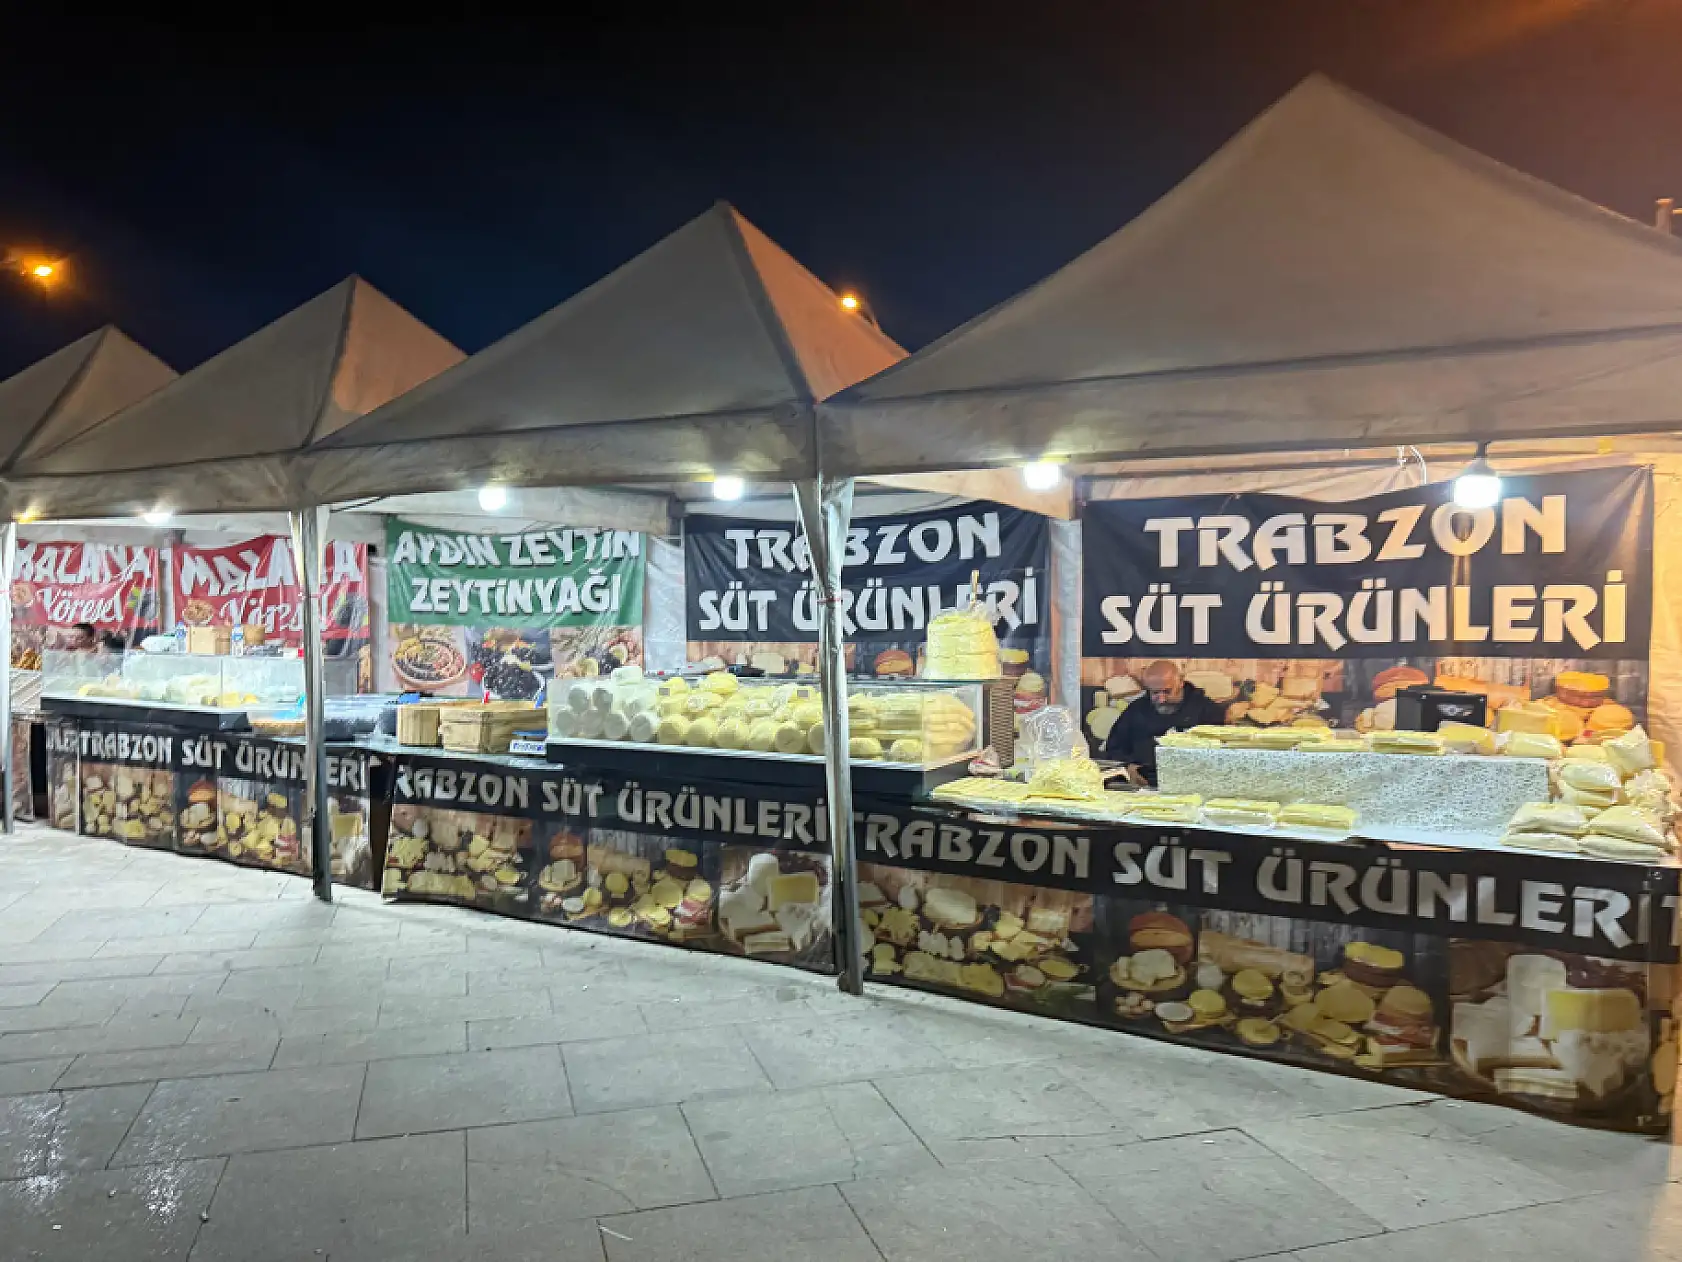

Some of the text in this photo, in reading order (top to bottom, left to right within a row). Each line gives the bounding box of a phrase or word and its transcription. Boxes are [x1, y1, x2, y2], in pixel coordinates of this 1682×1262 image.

[394, 530, 501, 567] AYDIN
[1144, 494, 1567, 572] TRABZON
[180, 538, 362, 596] MALAA
[409, 568, 622, 614] ZEYTİNYAĞI
[698, 581, 777, 632] SÜT
[1100, 569, 1626, 651] SÜT ÜRÜNLERİ
[80, 730, 173, 765] TRABZON
[181, 734, 228, 770] SÜT
[235, 740, 367, 791] ÜRÜNERİ
[394, 764, 828, 845] RABZON SÜT ÜRÜNLERİ
[1112, 836, 1233, 895] SÜT
[1256, 848, 1652, 948] ÜRÜNLERİ
